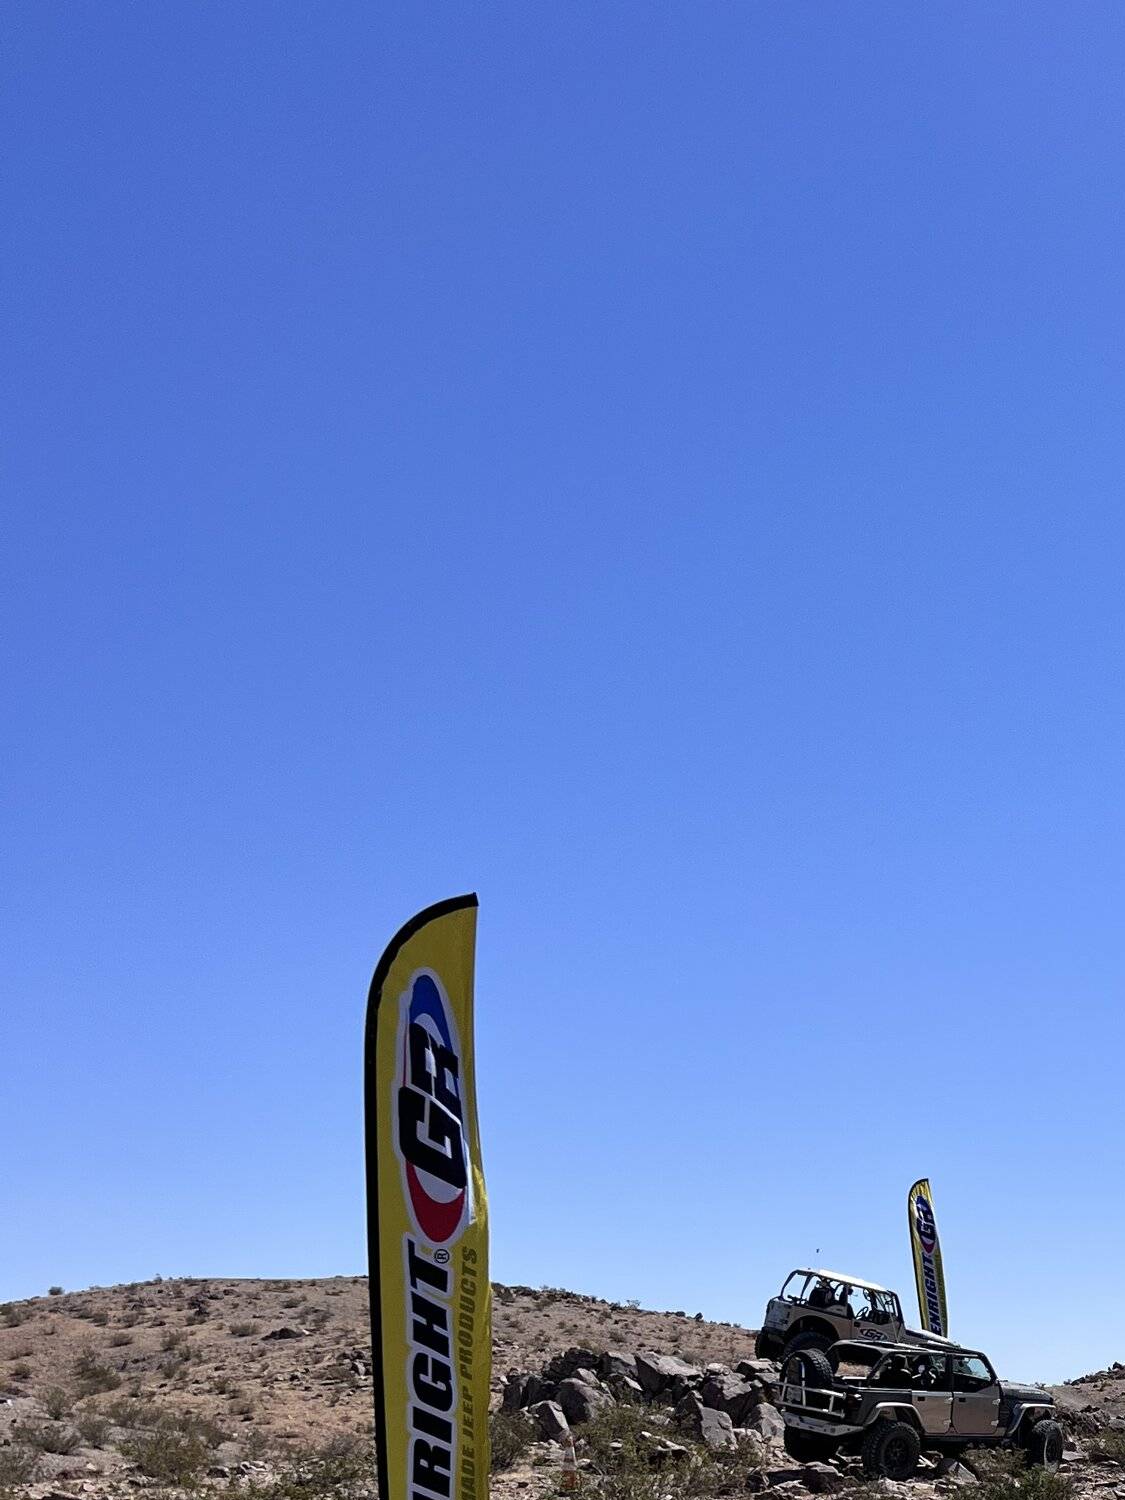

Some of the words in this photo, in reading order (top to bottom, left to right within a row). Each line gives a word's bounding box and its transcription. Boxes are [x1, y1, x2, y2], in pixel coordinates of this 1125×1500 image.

[397, 1021, 467, 1190] GR
[456, 1246, 478, 1380] PRODUCTS
[921, 1251, 942, 1337] ENRIGHT
[461, 1386, 475, 1440] JEEP
